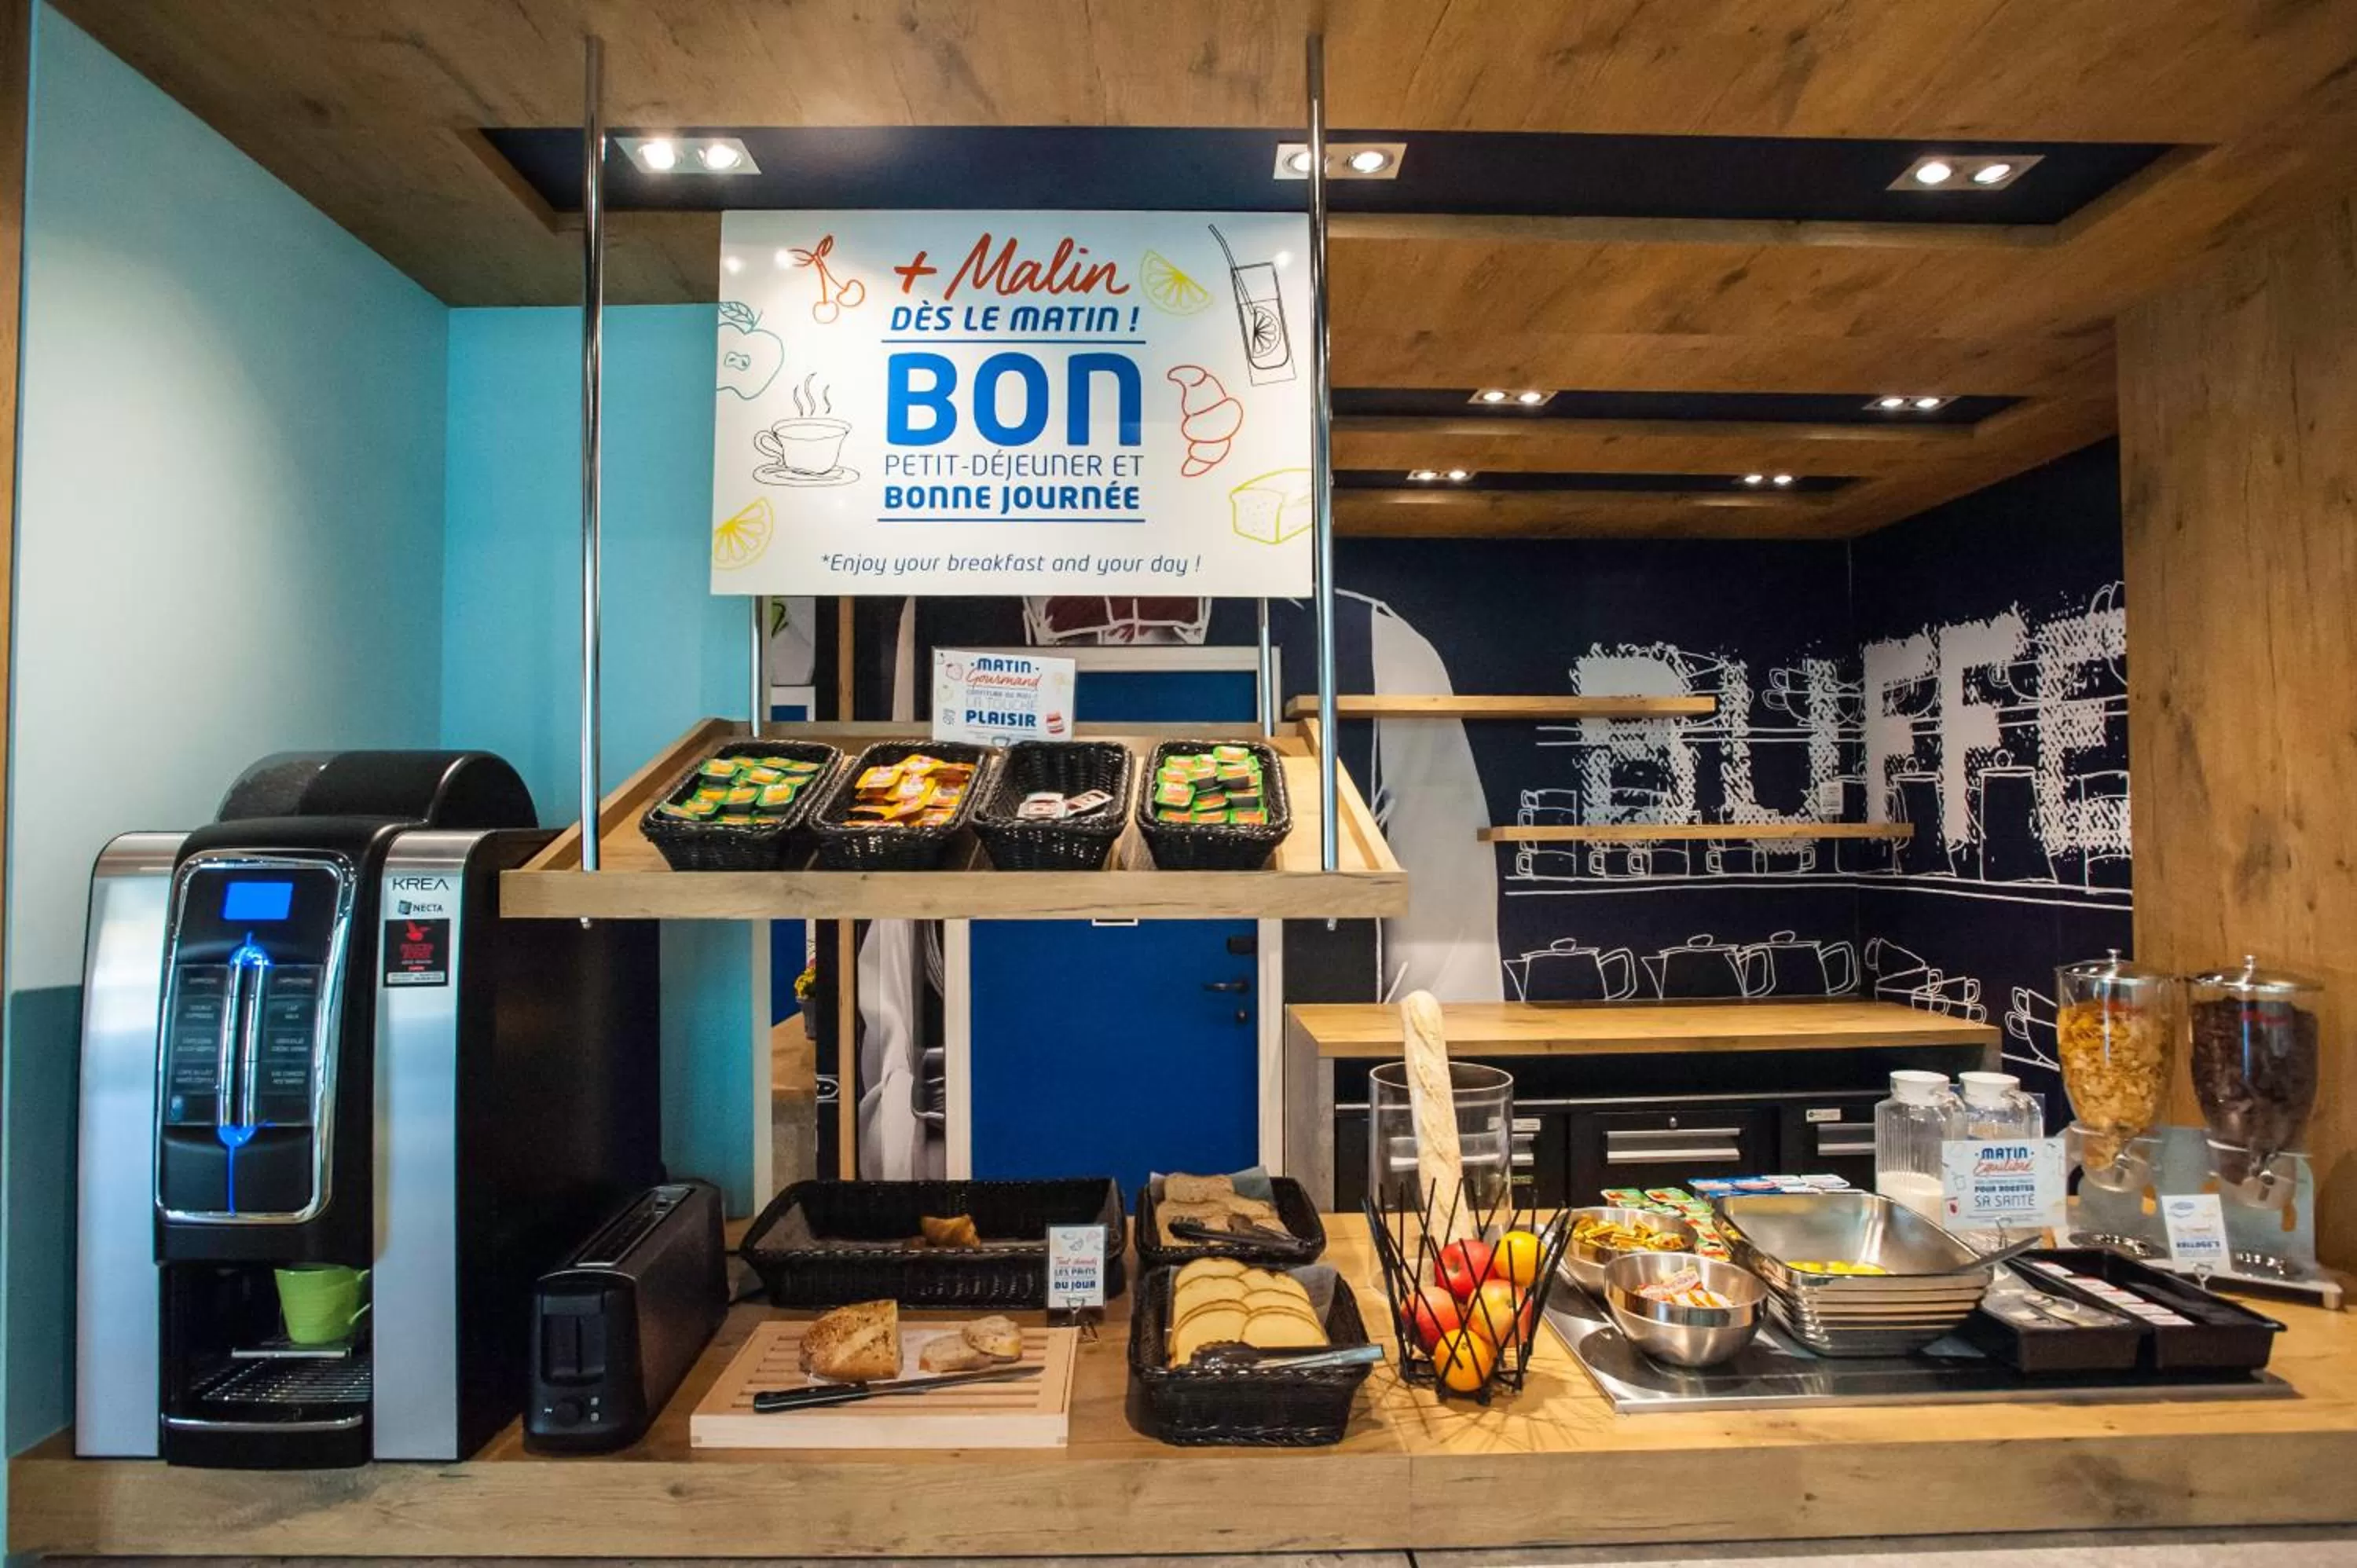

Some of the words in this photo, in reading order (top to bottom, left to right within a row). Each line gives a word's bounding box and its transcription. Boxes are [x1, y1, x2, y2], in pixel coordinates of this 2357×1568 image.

[943, 232, 1130, 300] Malin
[890, 301, 953, 332] DÈS
[963, 306, 1000, 332] LE
[1009, 306, 1120, 333] MATIN
[886, 351, 1142, 447] BON
[885, 451, 1103, 481] PETIT-DÉJEUNER
[1109, 453, 1145, 478] ET
[884, 485, 991, 510] BONNE
[1000, 482, 1140, 515] JOURNÉE
[894, 559, 940, 576] your
[947, 554, 1044, 573] breakfast
[1052, 554, 1091, 573] and
[1096, 559, 1144, 576] your
[1150, 555, 1189, 577] day
[977, 658, 1032, 674] MATIN
[966, 668, 1042, 691] Gourmand
[965, 709, 1036, 727] PLAISIR
[392, 877, 449, 891] KREA
[412, 903, 444, 912] NECTA
[1981, 1146, 2028, 1160] MATIN
[1974, 1195, 1991, 1207] SA
[1995, 1192, 2035, 1207] SANTÉ
[1054, 1280, 1069, 1290] DU
[1071, 1280, 1096, 1291] JOUR
